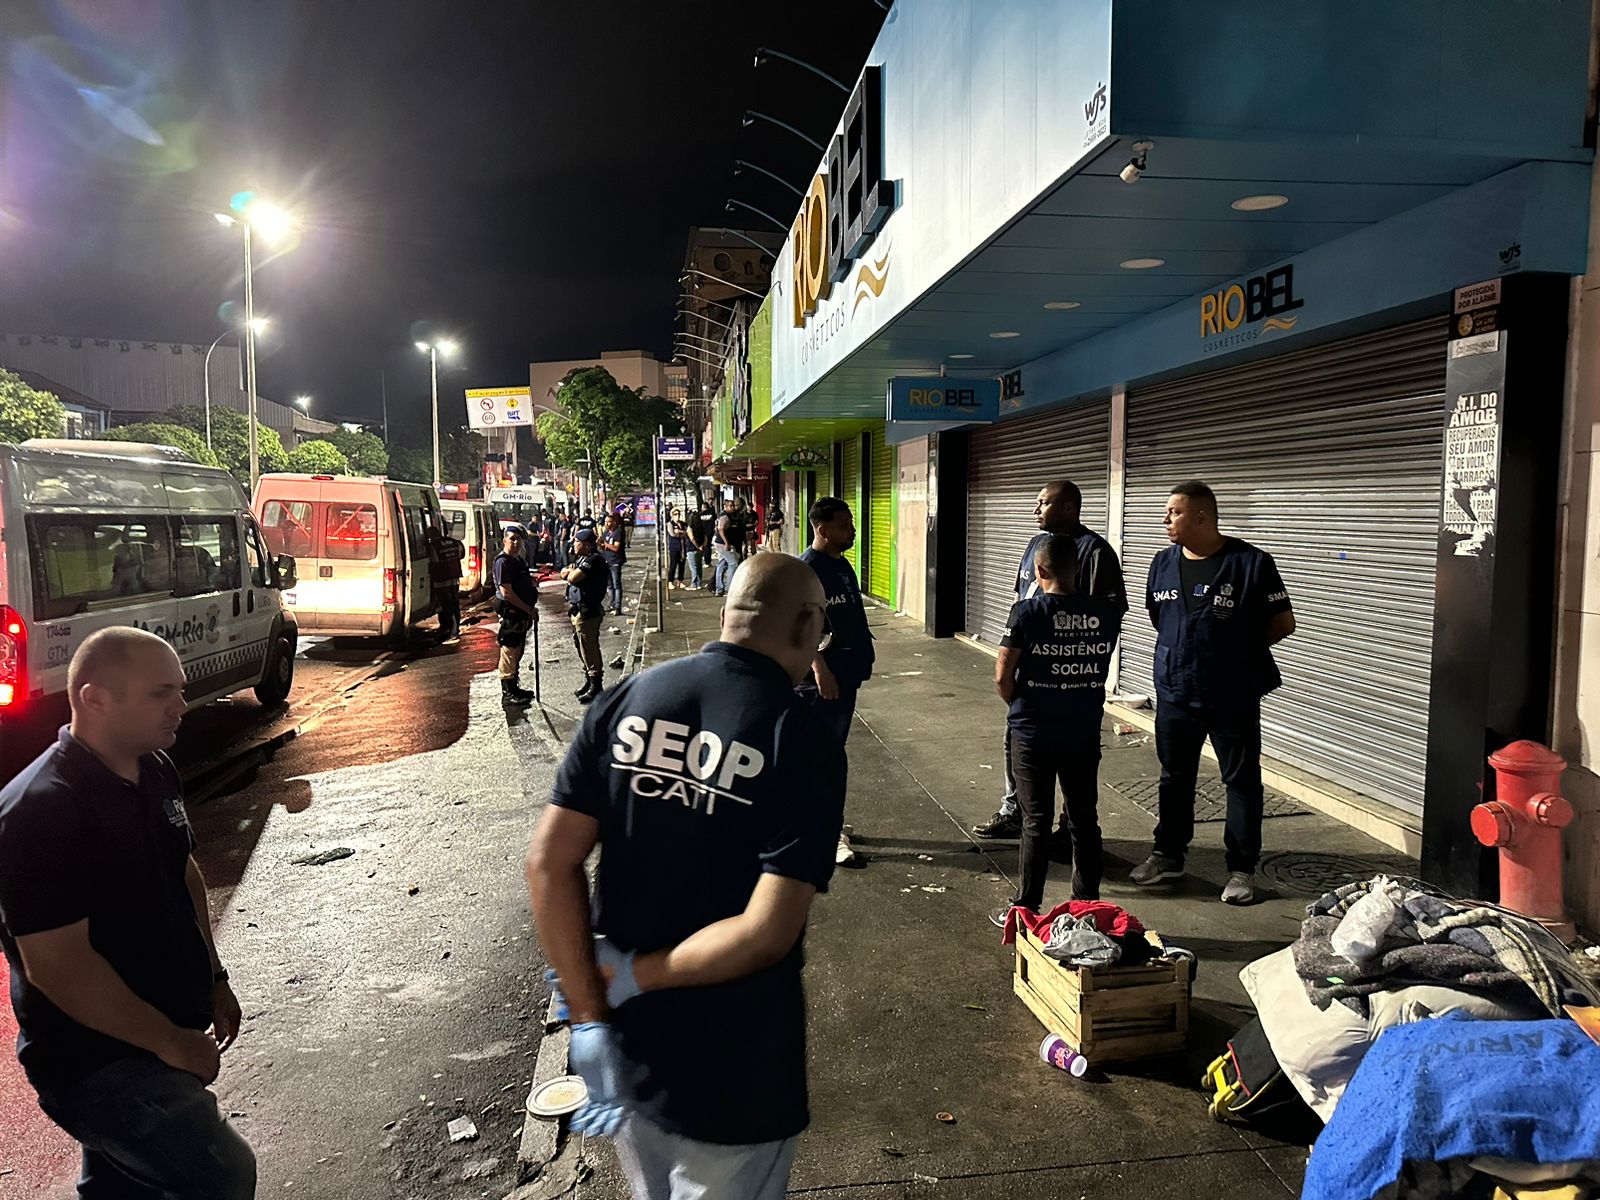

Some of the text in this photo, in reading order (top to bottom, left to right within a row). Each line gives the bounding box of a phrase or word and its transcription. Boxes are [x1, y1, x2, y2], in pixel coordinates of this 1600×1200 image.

[793, 65, 895, 328] RIOBEL
[1460, 284, 1496, 299] PROTEGIDO
[1201, 264, 1304, 338] RIOBEL
[909, 388, 982, 407] RIOBEL
[1481, 392, 1497, 408] DO
[1448, 426, 1496, 442] RECUPERAMOS
[1449, 440, 1494, 455] SEU AMOR
[1457, 455, 1485, 469] DE VOLTA
[502, 492, 533, 501] GM-Rio
[1477, 499, 1494, 510] PARA
[1445, 511, 1465, 521] TODOS
[1213, 596, 1235, 608] Rio
[1267, 590, 1289, 603] SMA
[1072, 614, 1100, 630] Rio
[48, 645, 69, 660] GTM
[1032, 641, 1111, 656] ASSISTÊNCI
[1051, 662, 1100, 675] SOCIAL
[612, 715, 765, 790] SEOP
